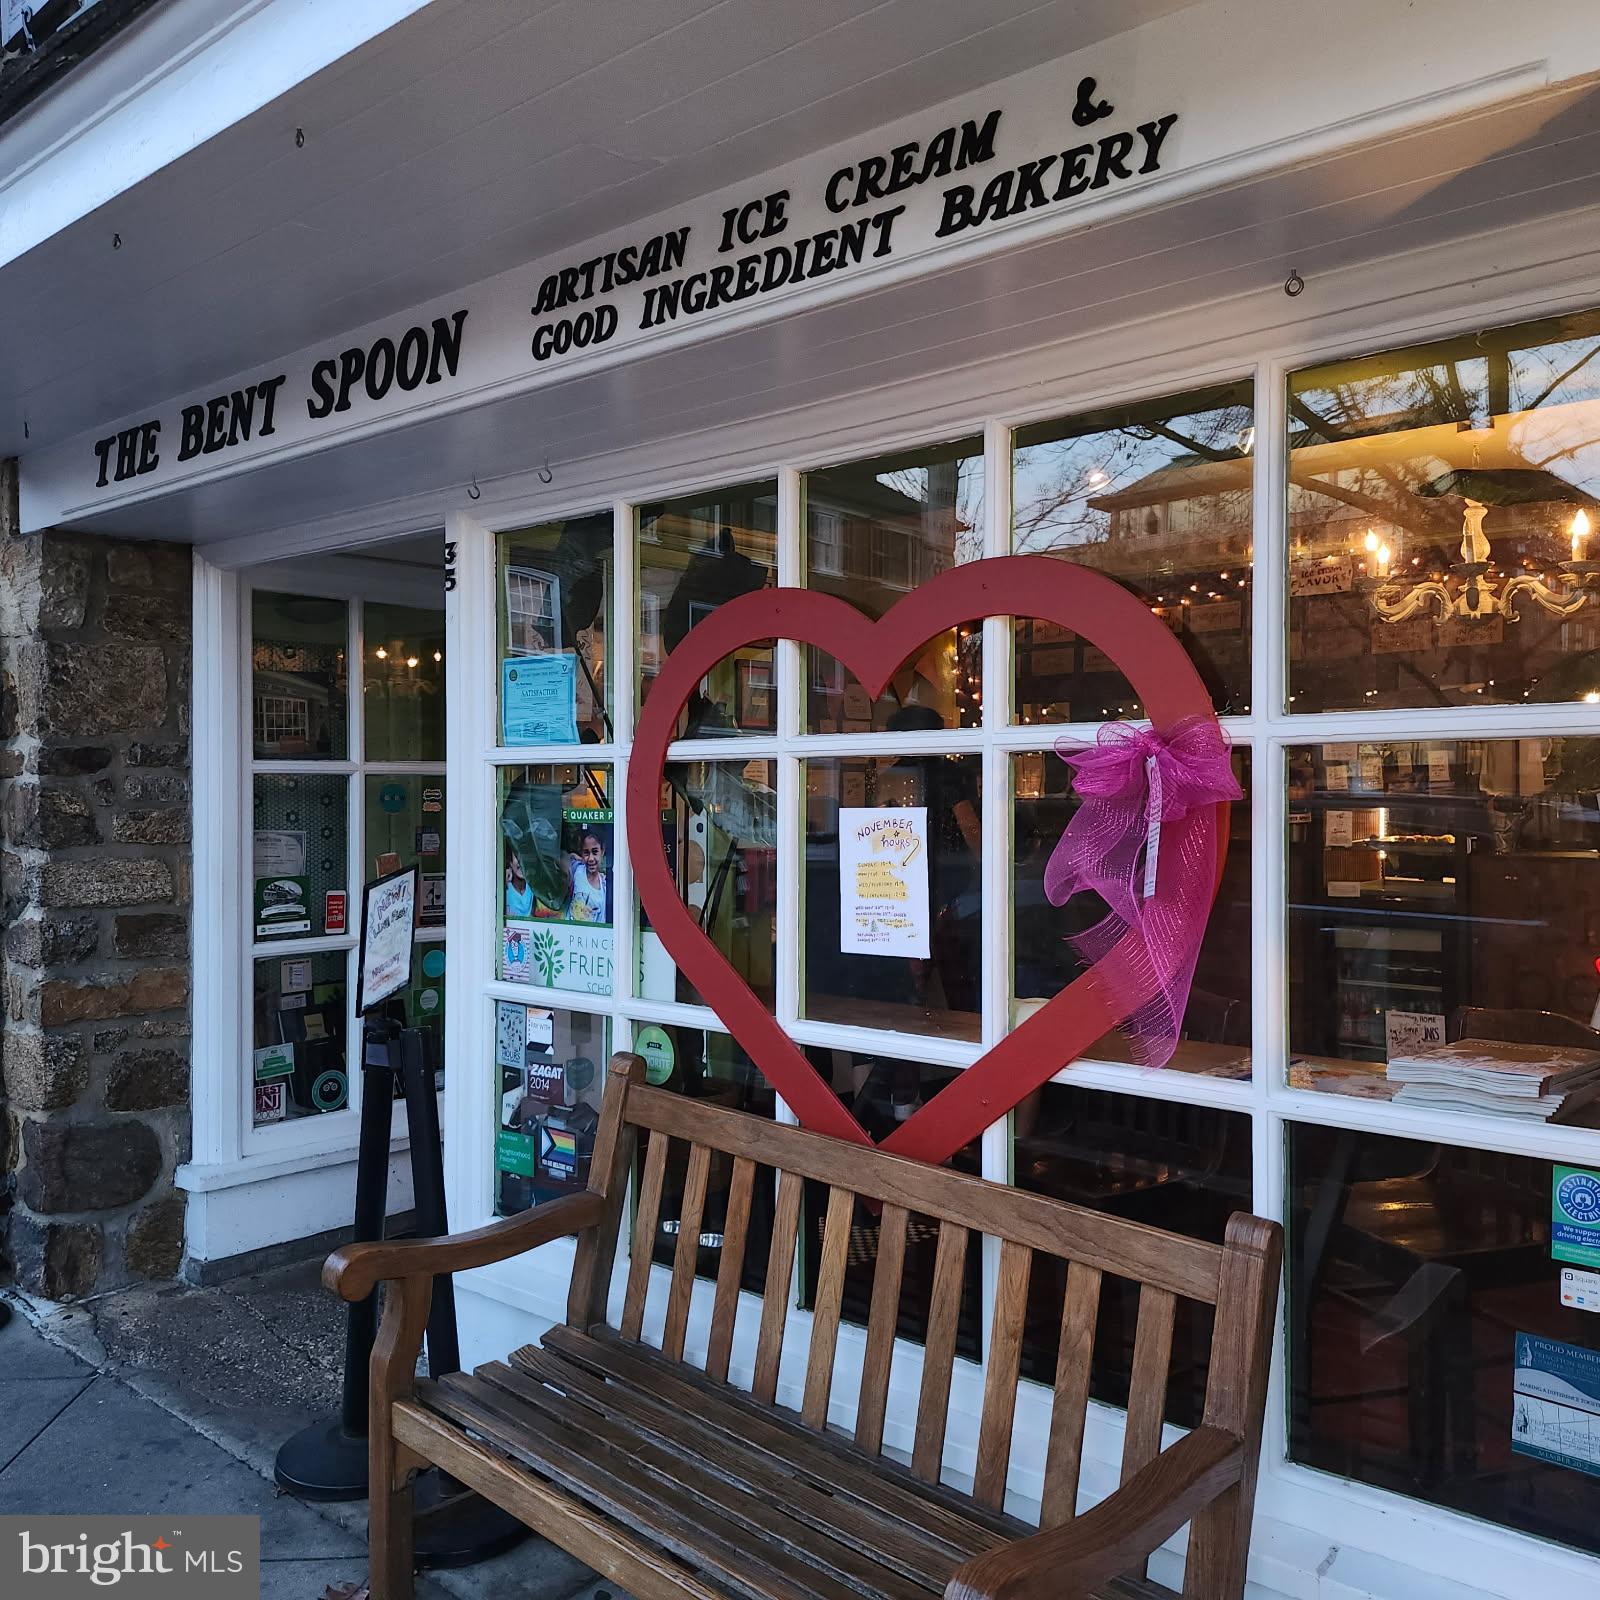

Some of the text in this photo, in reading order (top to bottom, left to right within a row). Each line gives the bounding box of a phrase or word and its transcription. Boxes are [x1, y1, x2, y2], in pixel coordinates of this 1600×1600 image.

[531, 76, 1114, 315] ARTISAN ICE CREAM &
[531, 113, 1178, 361] GOOD INGREDIENT BAKERY
[95, 309, 468, 488] THE BENT SPOON
[570, 811, 605, 820] QUAKER
[857, 818, 913, 841] NOVEMBER
[531, 1063, 564, 1080] ZAGAT
[257, 1084, 281, 1096] BEST
[529, 1077, 551, 1091] 2014
[1556, 1230, 1582, 1242] driving
[1562, 1225, 1600, 1238] We suppor
[1534, 1340, 1564, 1354] PROUD
